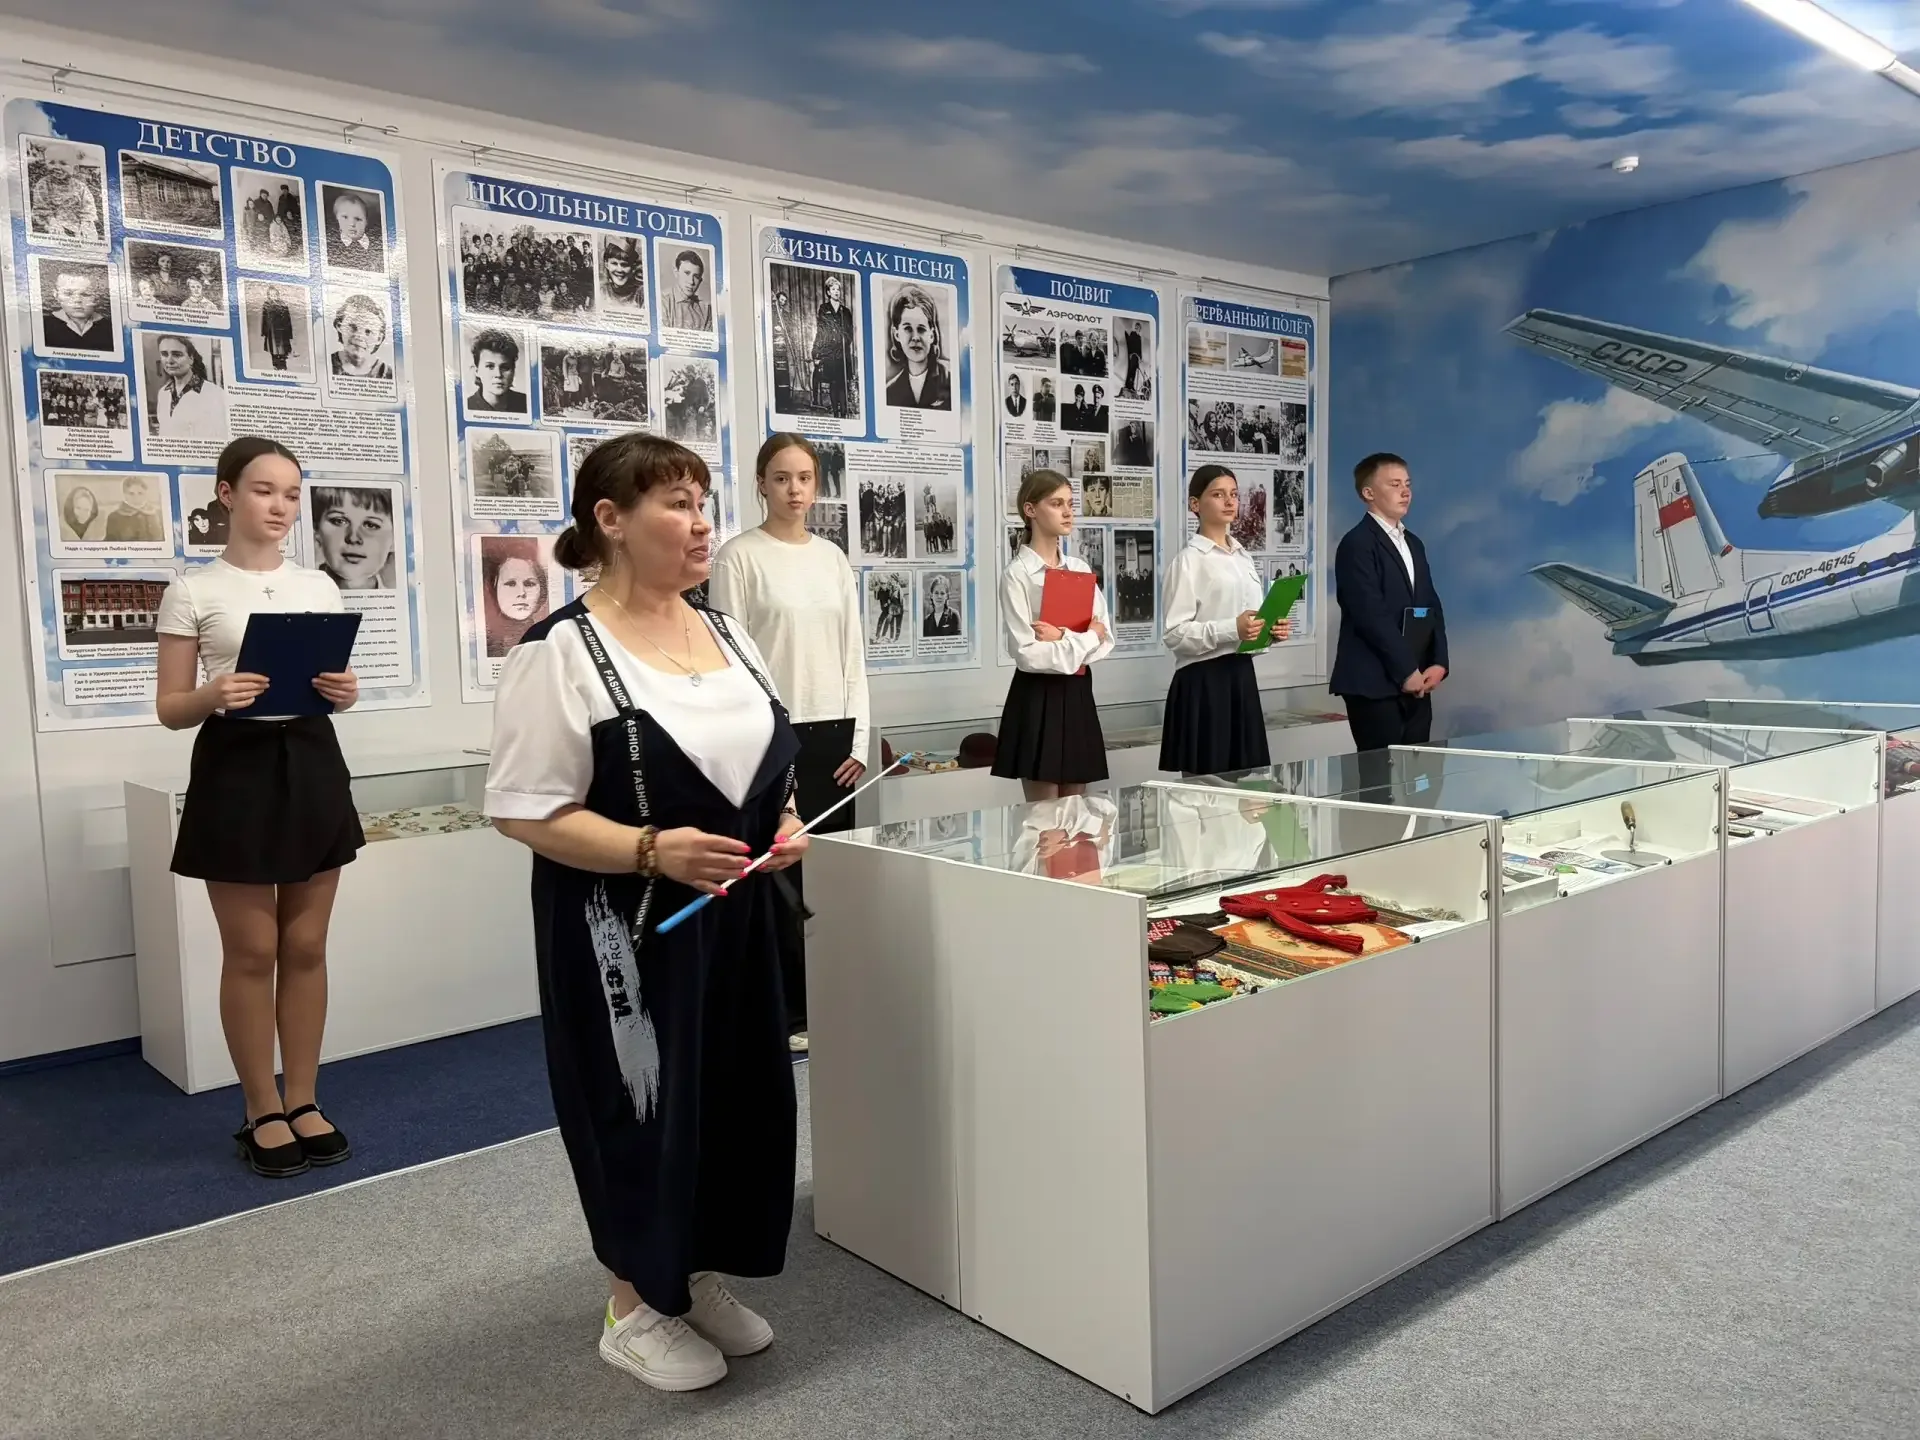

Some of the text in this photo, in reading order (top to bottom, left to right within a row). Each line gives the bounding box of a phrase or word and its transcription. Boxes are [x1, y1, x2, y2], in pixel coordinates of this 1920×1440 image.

[137, 121, 297, 170] ДЕТСТВО
[466, 180, 704, 238] ШКОЛЬНЫЕ ГОДЫ
[766, 235, 956, 280] ЖИЗНЬ КАК ПЕСНЯ
[1050, 280, 1112, 304] ПОДВИГ
[1046, 310, 1103, 324] АЭРОФЛОТ
[1186, 304, 1269, 328] ПРЕРВАННЫЙ
[1590, 341, 1689, 376] СССР
[1781, 552, 1856, 586] СССР-46745
[580, 624, 607, 664] FASHION
[603, 669, 630, 708] FASHION
[626, 718, 640, 761] ASHION
[632, 769, 650, 817] FASHION
